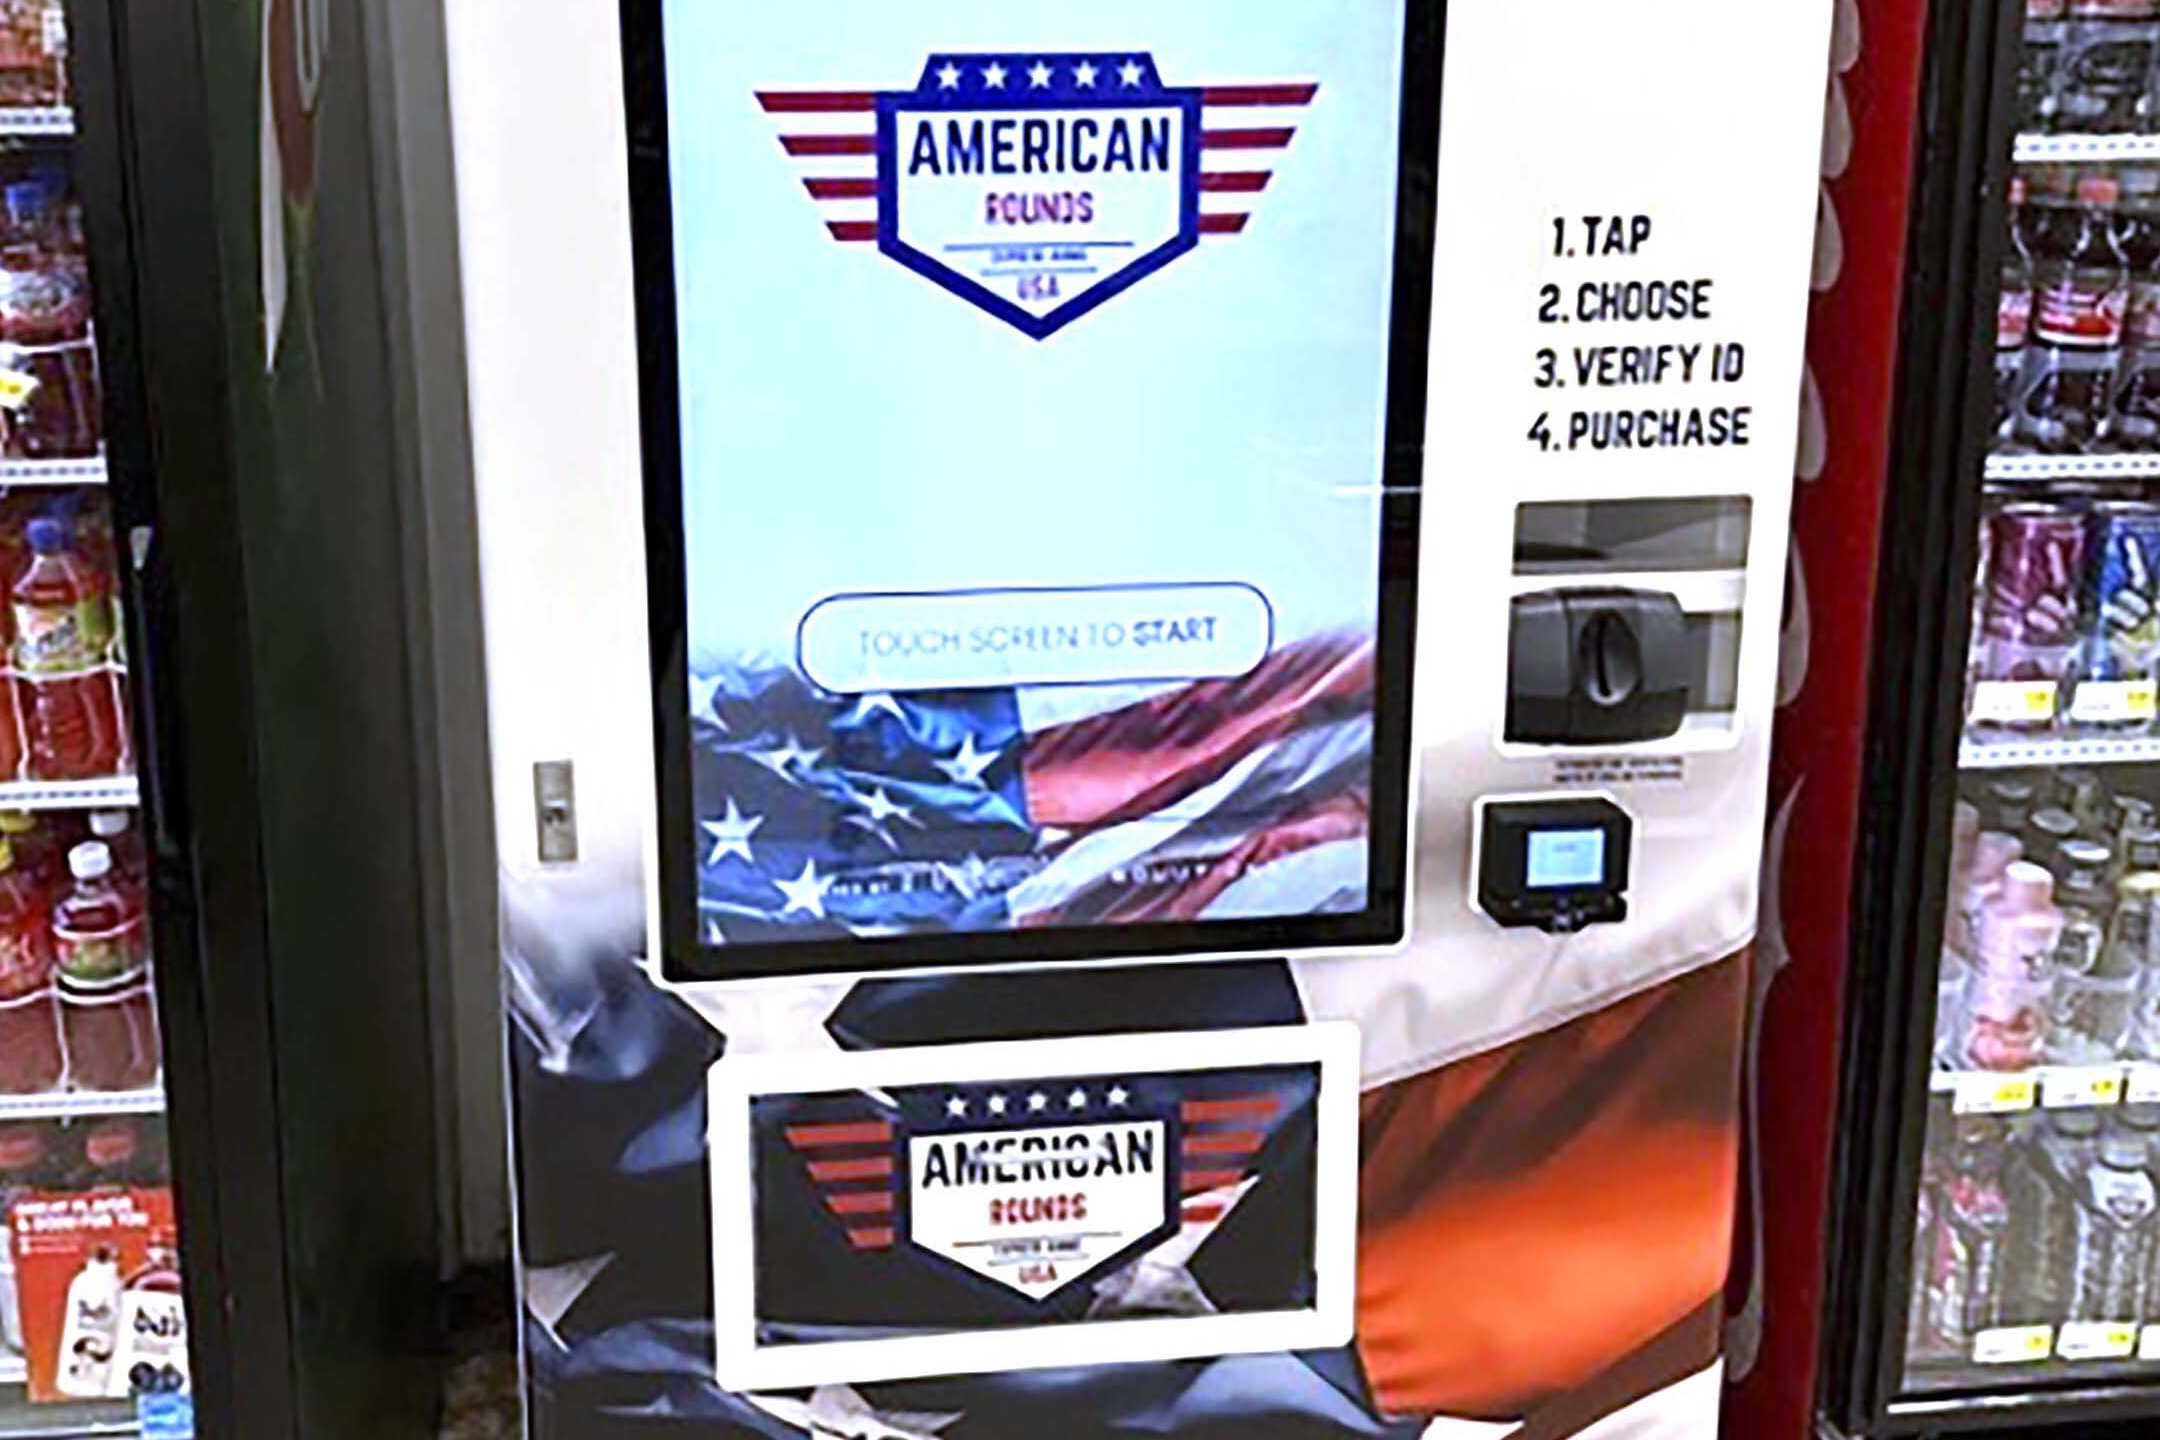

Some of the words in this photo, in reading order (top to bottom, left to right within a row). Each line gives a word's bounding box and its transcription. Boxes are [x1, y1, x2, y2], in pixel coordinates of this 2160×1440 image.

[908, 117, 1170, 175] AMERICAN
[985, 190, 1094, 226] ROUNDS
[1582, 214, 1652, 256] TAP
[1576, 279, 1714, 322] CHOOSE
[1573, 343, 1702, 386] VERIFY
[1710, 342, 1745, 382] ID
[1567, 406, 1752, 451] PURCHASE
[859, 628, 961, 657] TOUCH
[969, 624, 1078, 653] SCREEN
[1088, 620, 1127, 648] TO
[1132, 616, 1217, 647] START
[922, 1129, 1154, 1189] AMERICAN
